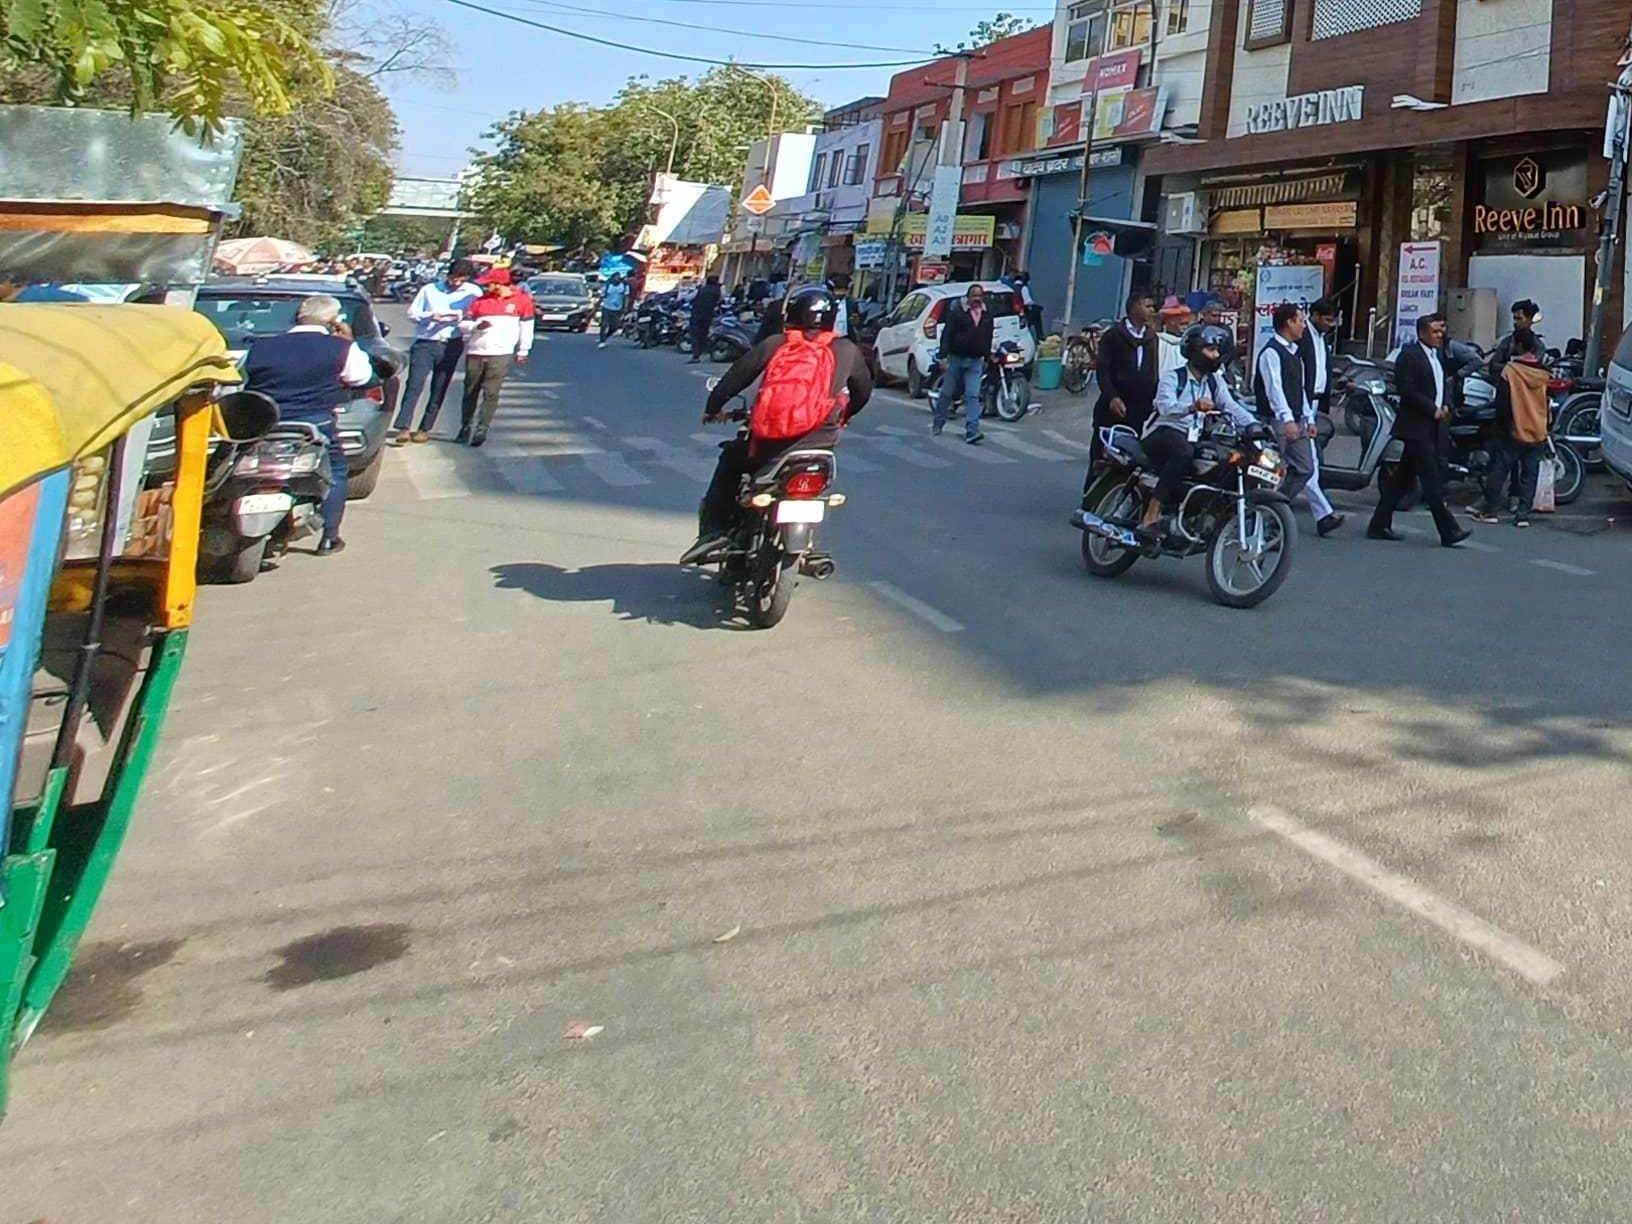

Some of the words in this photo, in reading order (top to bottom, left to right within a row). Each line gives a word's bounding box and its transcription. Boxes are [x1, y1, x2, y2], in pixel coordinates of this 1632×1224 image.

[1246, 94, 1318, 134] REEVE
[1316, 85, 1365, 126] INN
[1474, 205, 1537, 233] Reeve
[1542, 200, 1579, 231] Inn
[1409, 257, 1428, 270] A.C.
